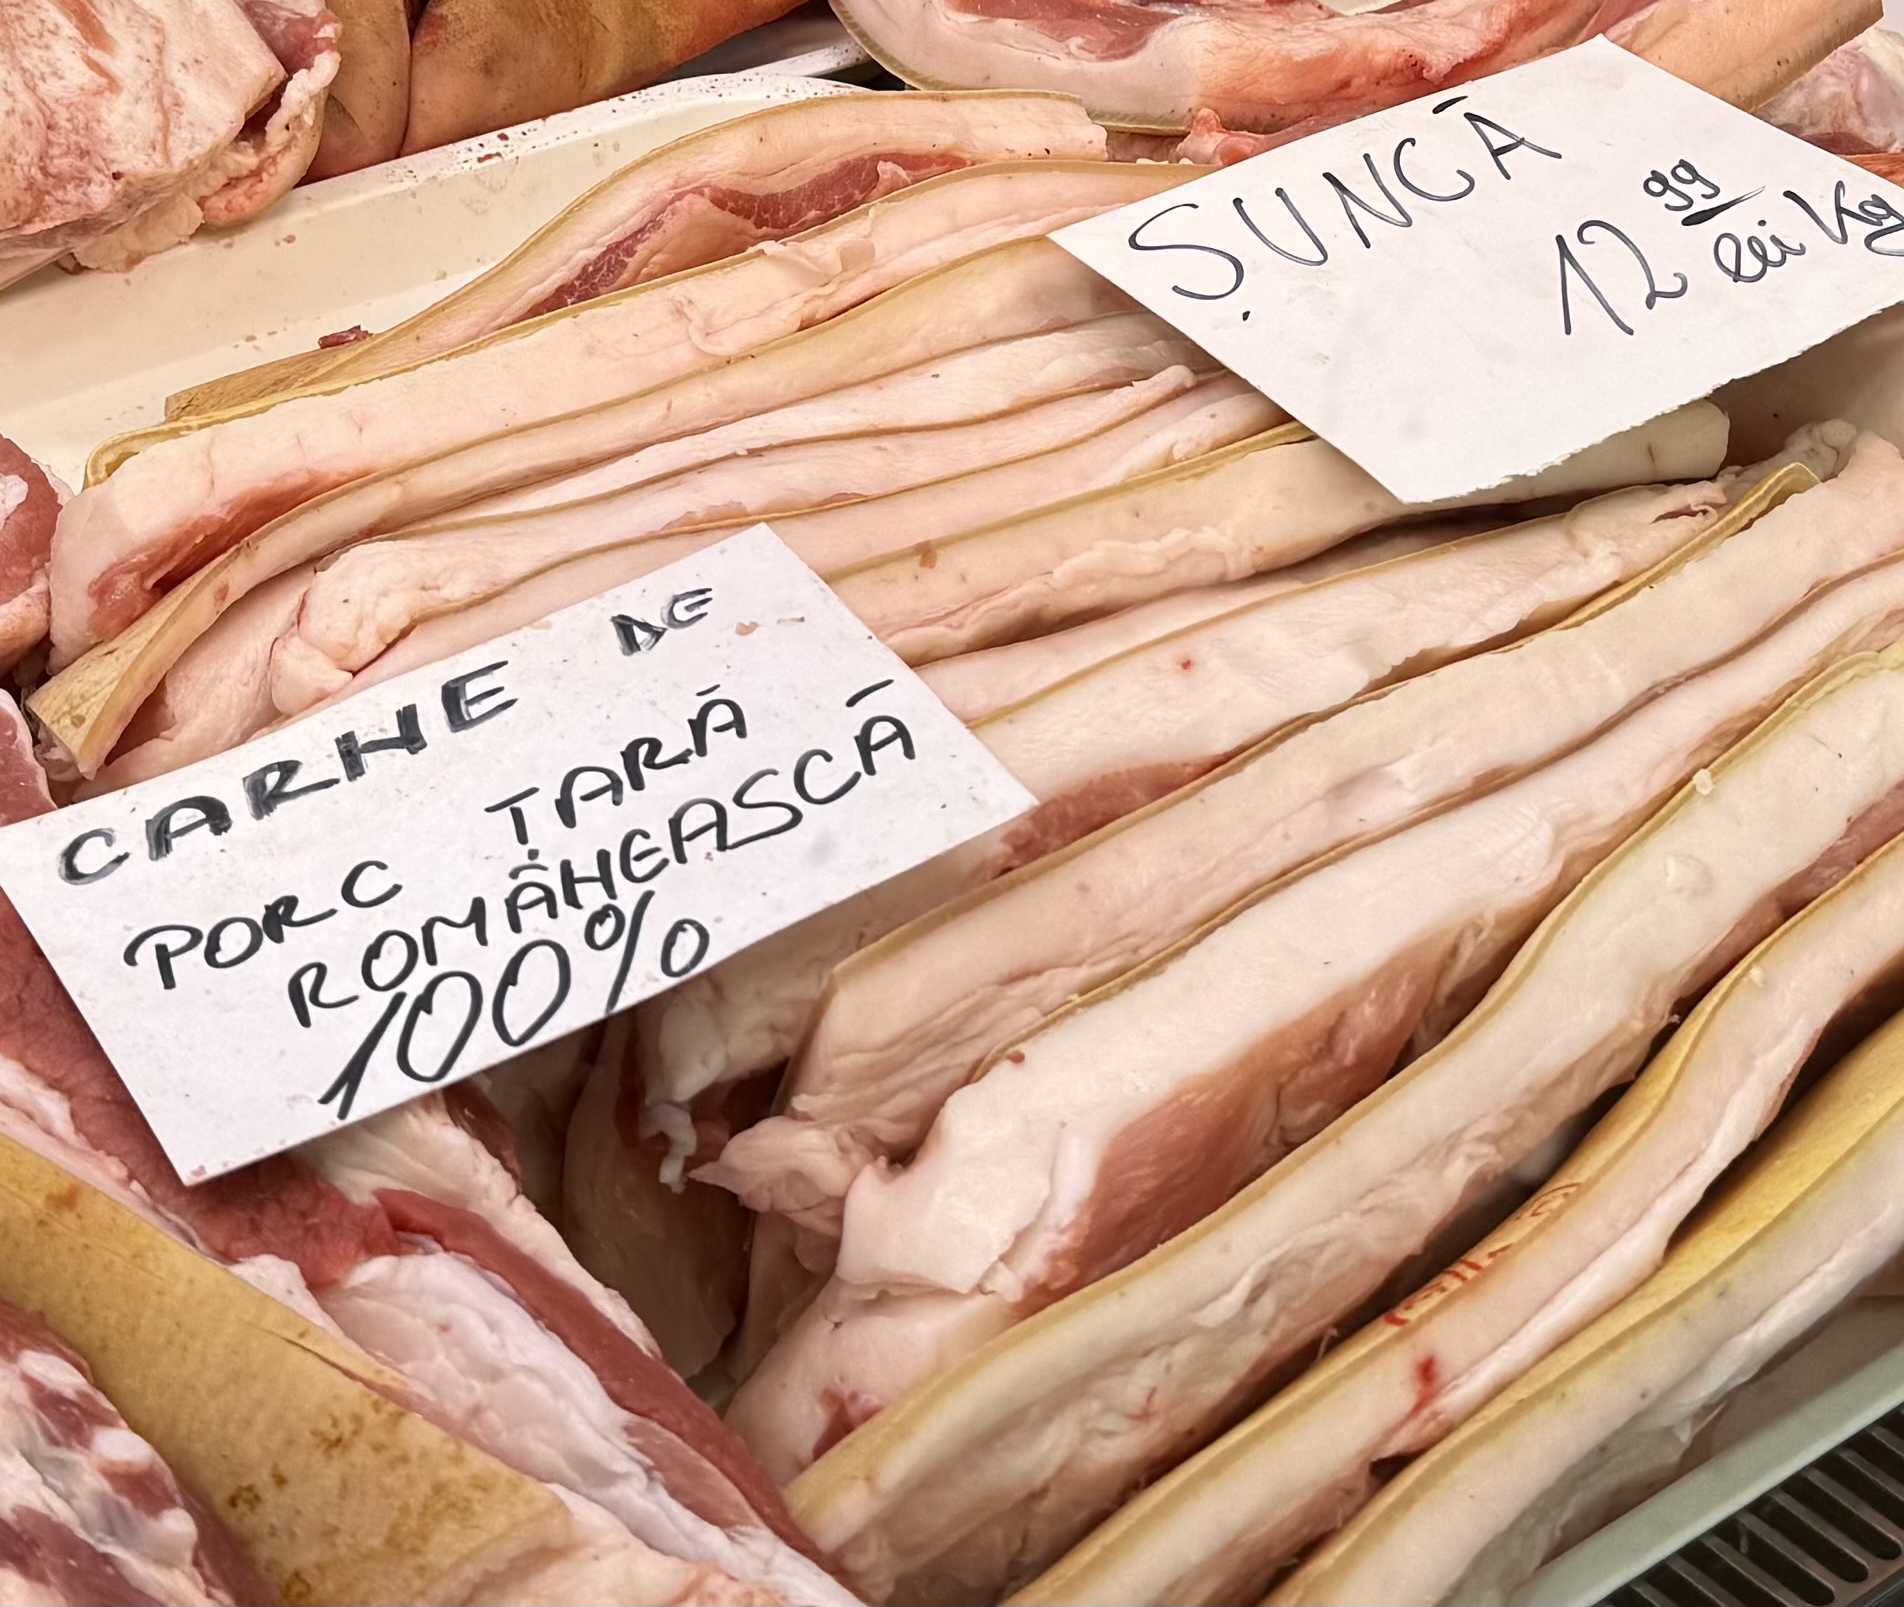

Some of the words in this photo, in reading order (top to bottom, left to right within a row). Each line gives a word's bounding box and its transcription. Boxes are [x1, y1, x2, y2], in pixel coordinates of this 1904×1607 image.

[1552, 218, 1688, 337] 12
[123, 857, 403, 990] PORC
[318, 888, 710, 1121] 100%
